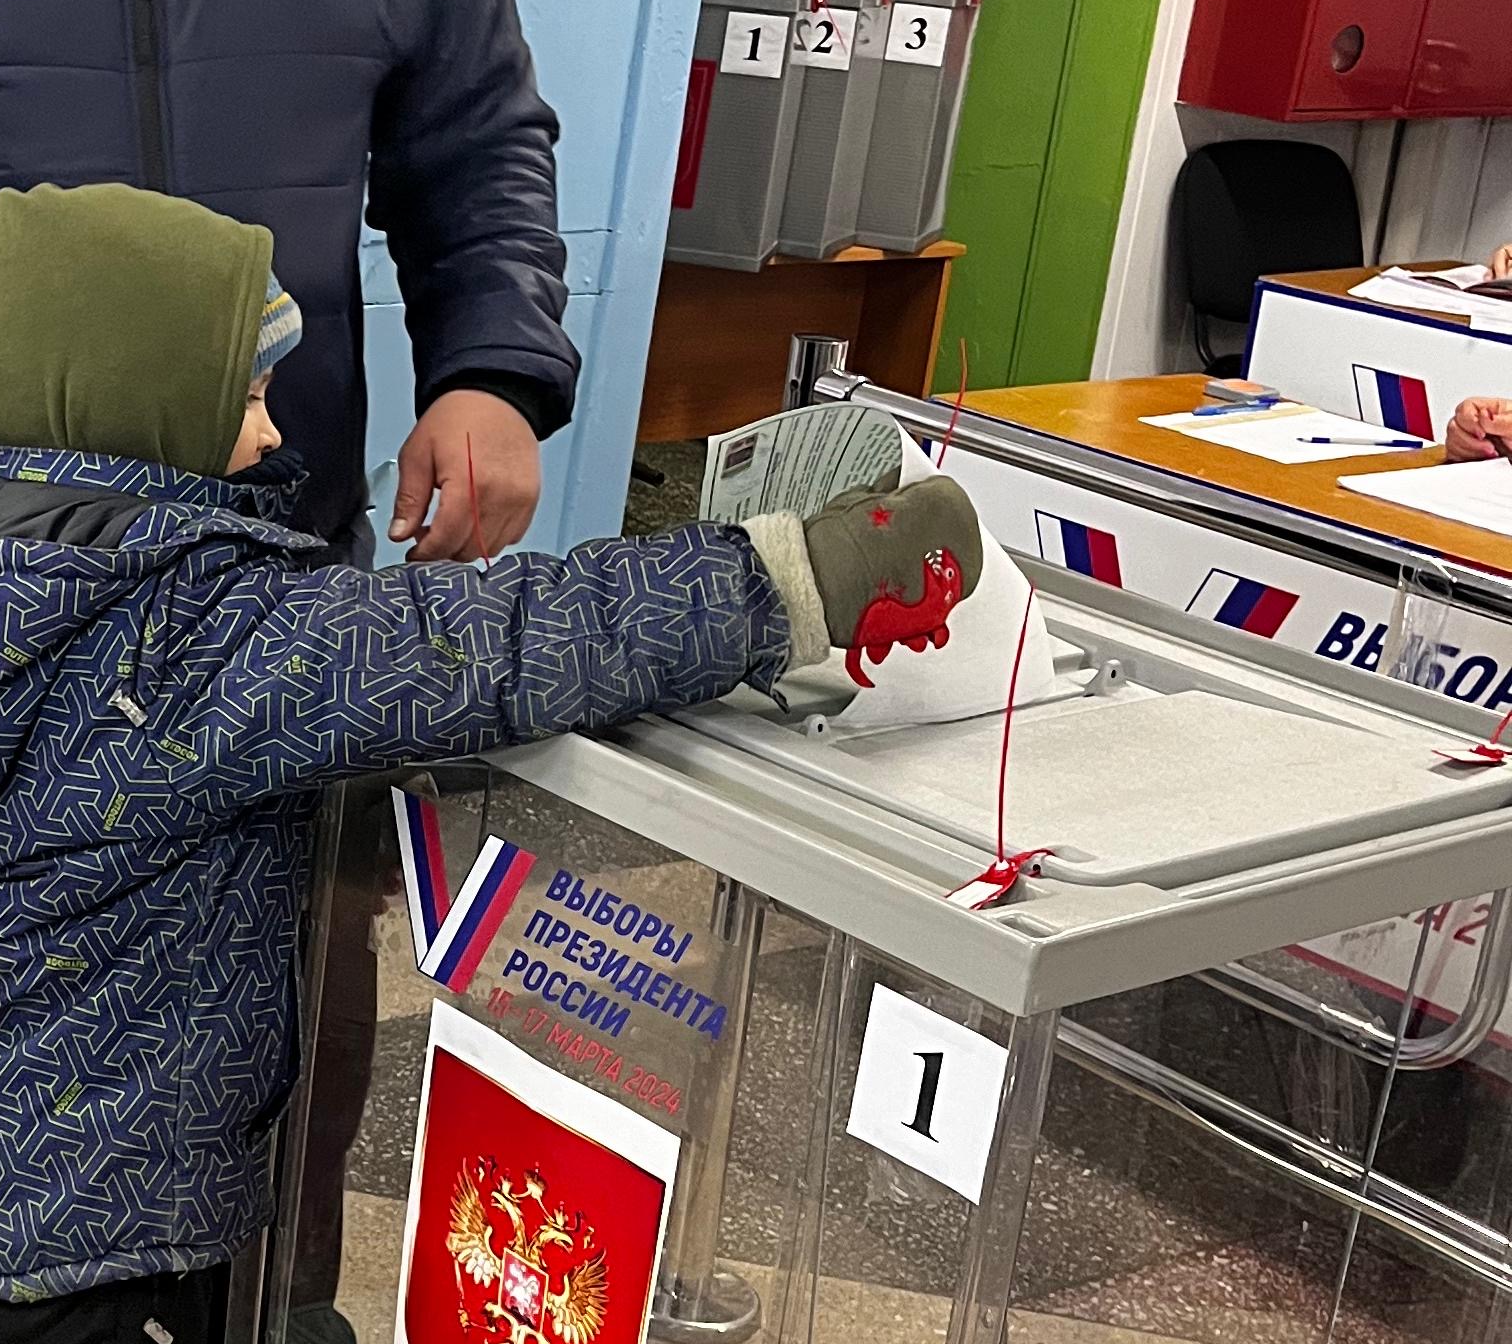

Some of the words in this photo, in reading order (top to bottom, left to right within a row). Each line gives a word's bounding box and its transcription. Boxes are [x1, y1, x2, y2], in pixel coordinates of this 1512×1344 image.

[743, 27, 762, 61] 1
[811, 20, 834, 53] 2
[904, 17, 928, 50] 3
[544, 868, 694, 964] ВЫБОРЫ
[501, 948, 632, 1038] РОССИИ
[522, 908, 729, 1042] ПРЕЗИДЕНТА
[545, 1021, 626, 1084] МАРТА
[622, 1065, 683, 1116] 2024
[901, 1052, 944, 1143] 1
